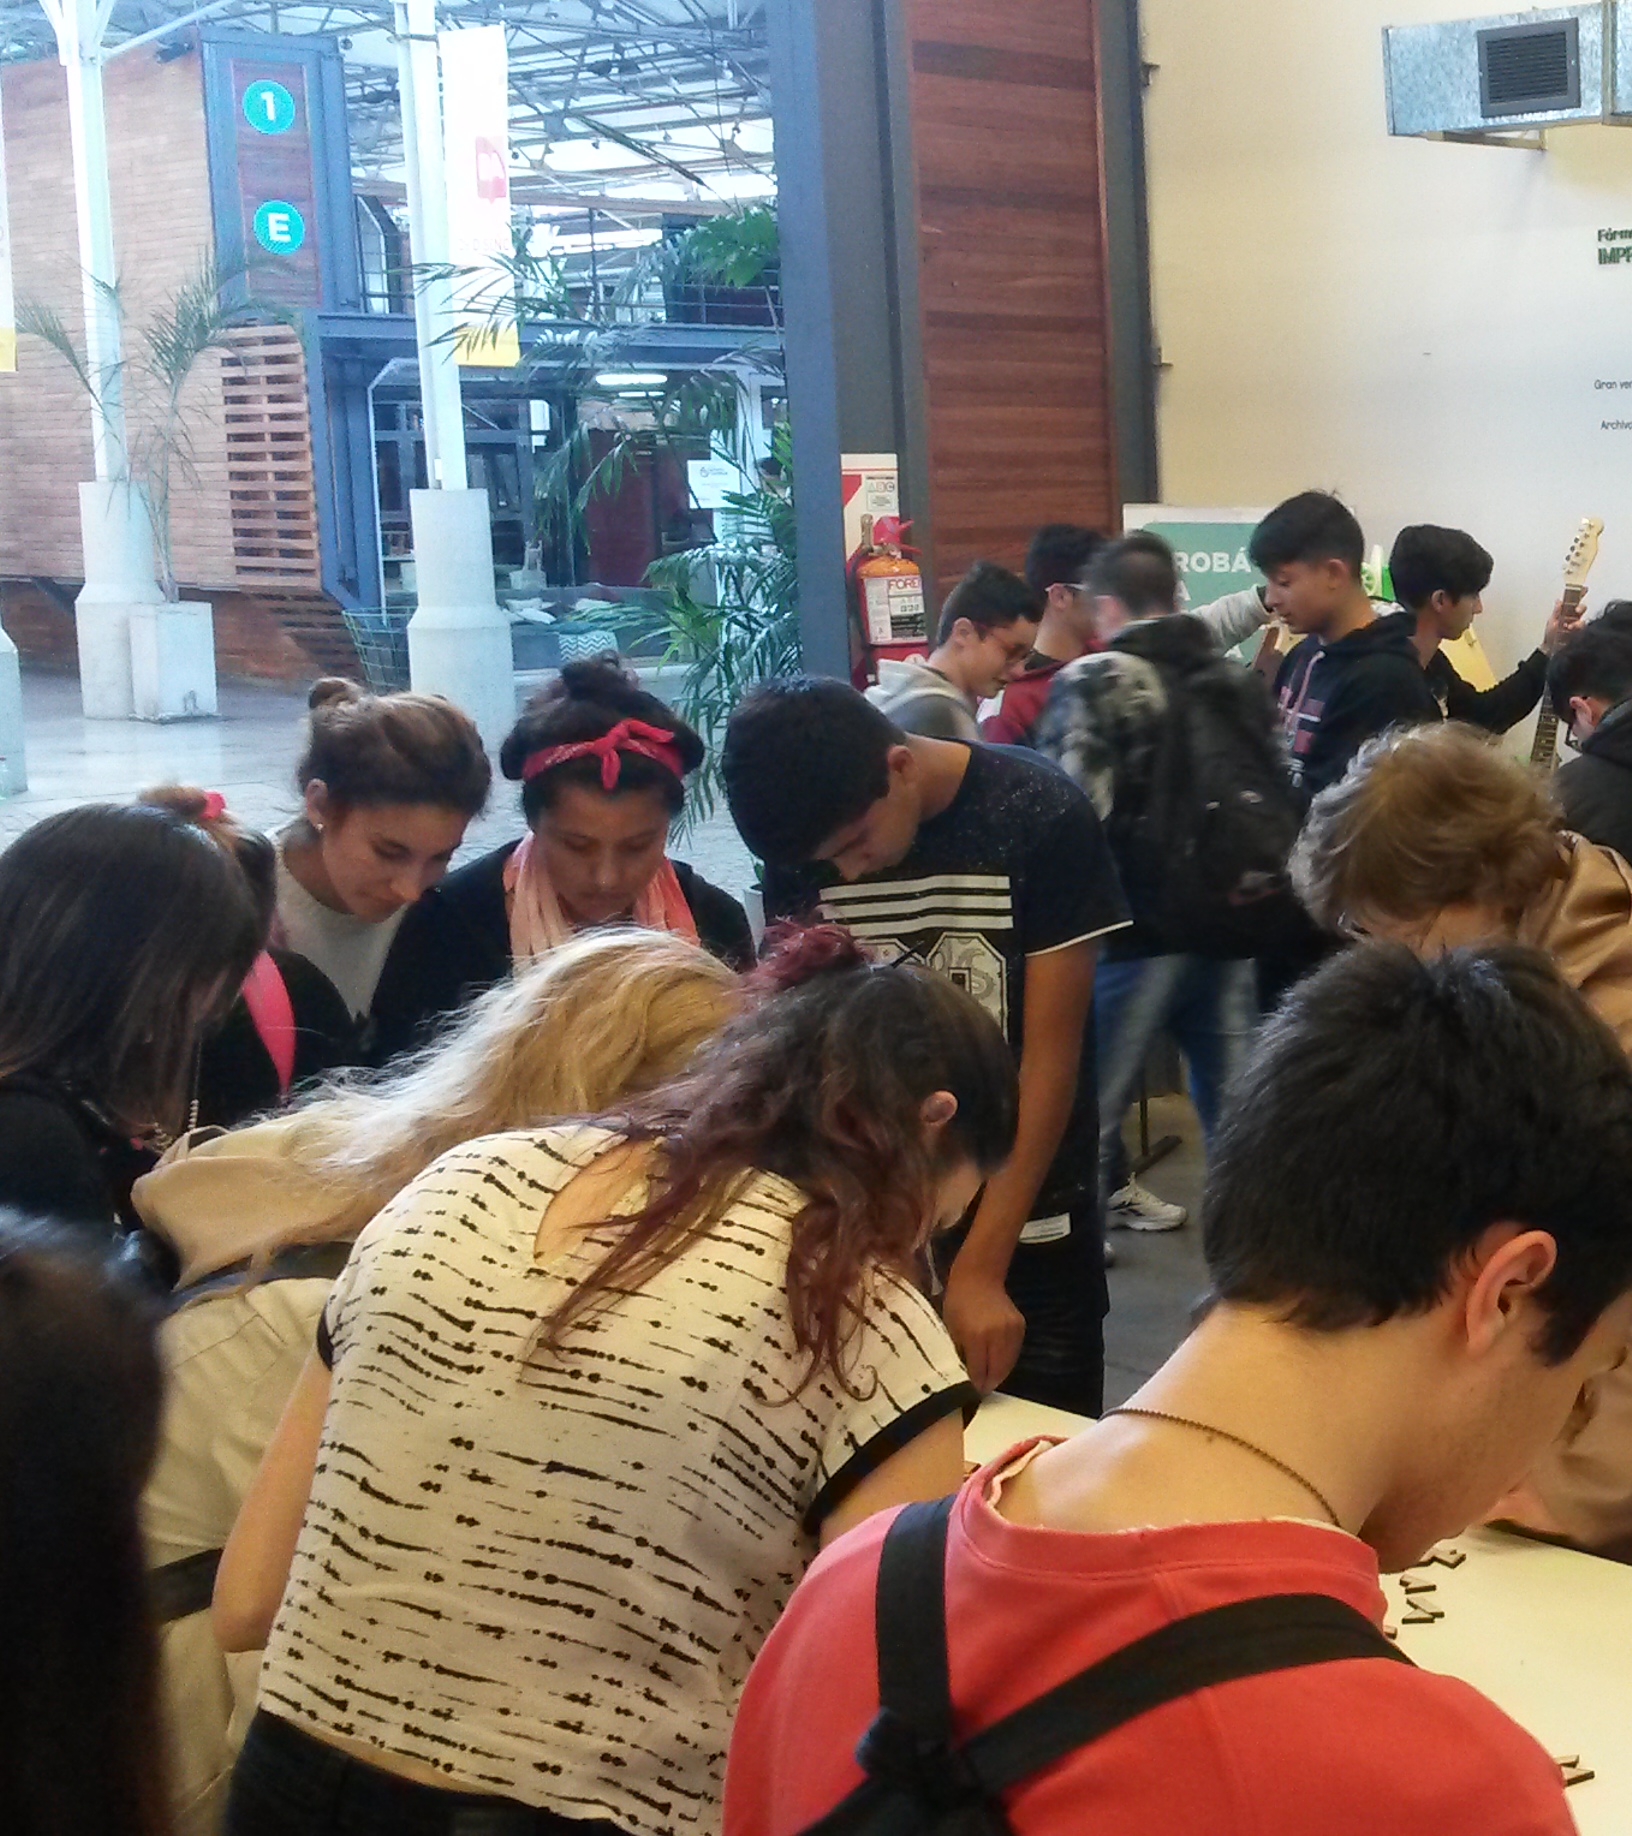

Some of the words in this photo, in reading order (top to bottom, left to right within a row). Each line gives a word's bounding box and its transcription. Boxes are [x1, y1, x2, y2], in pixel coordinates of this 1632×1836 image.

[259, 91, 276, 121] 1
[268, 213, 292, 243] E
[1594, 379, 1617, 390] Gran
